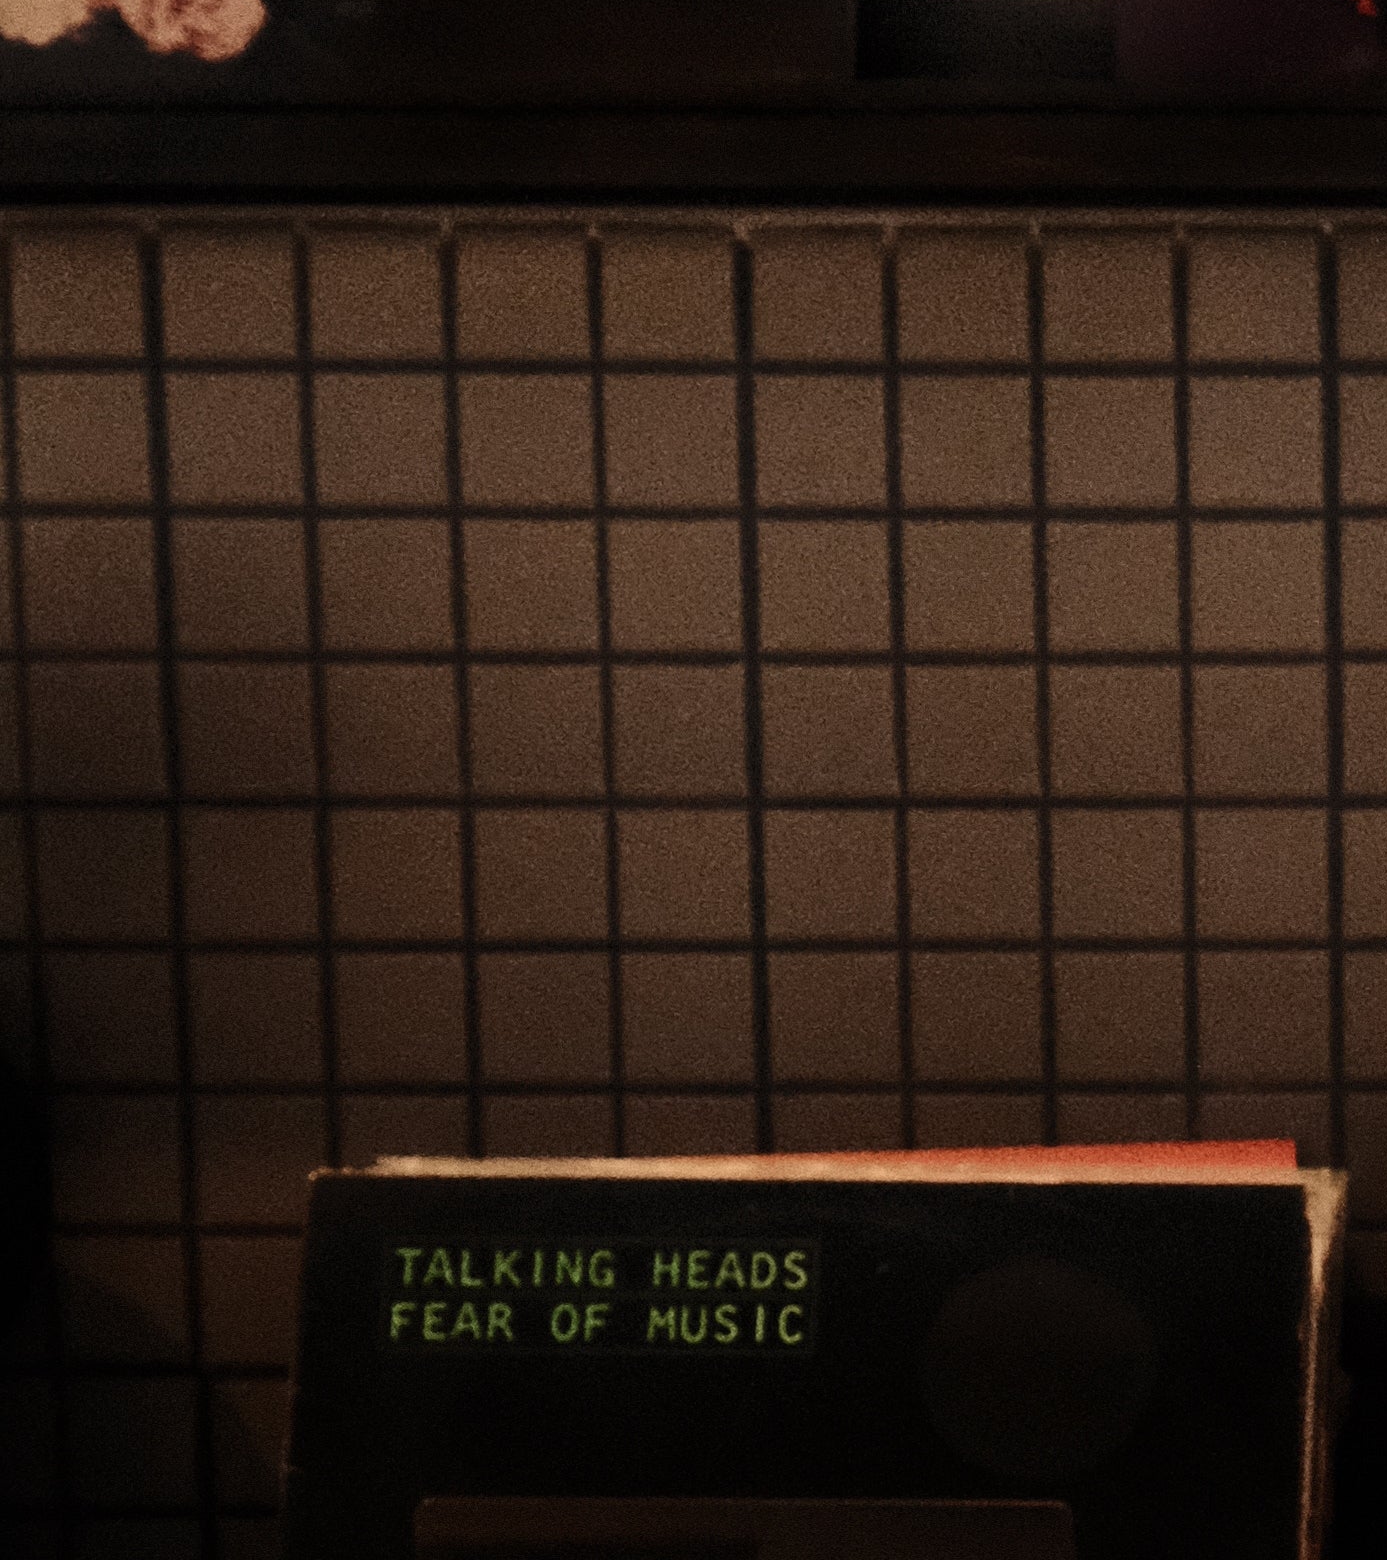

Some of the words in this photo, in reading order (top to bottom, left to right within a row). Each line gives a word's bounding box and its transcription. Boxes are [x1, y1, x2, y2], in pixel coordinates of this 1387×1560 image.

[395, 1246, 616, 1288] TALKING
[651, 1248, 809, 1291] HEADS
[389, 1301, 514, 1342] FEAR
[550, 1302, 610, 1344] OF
[646, 1303, 805, 1346] MUSIC
